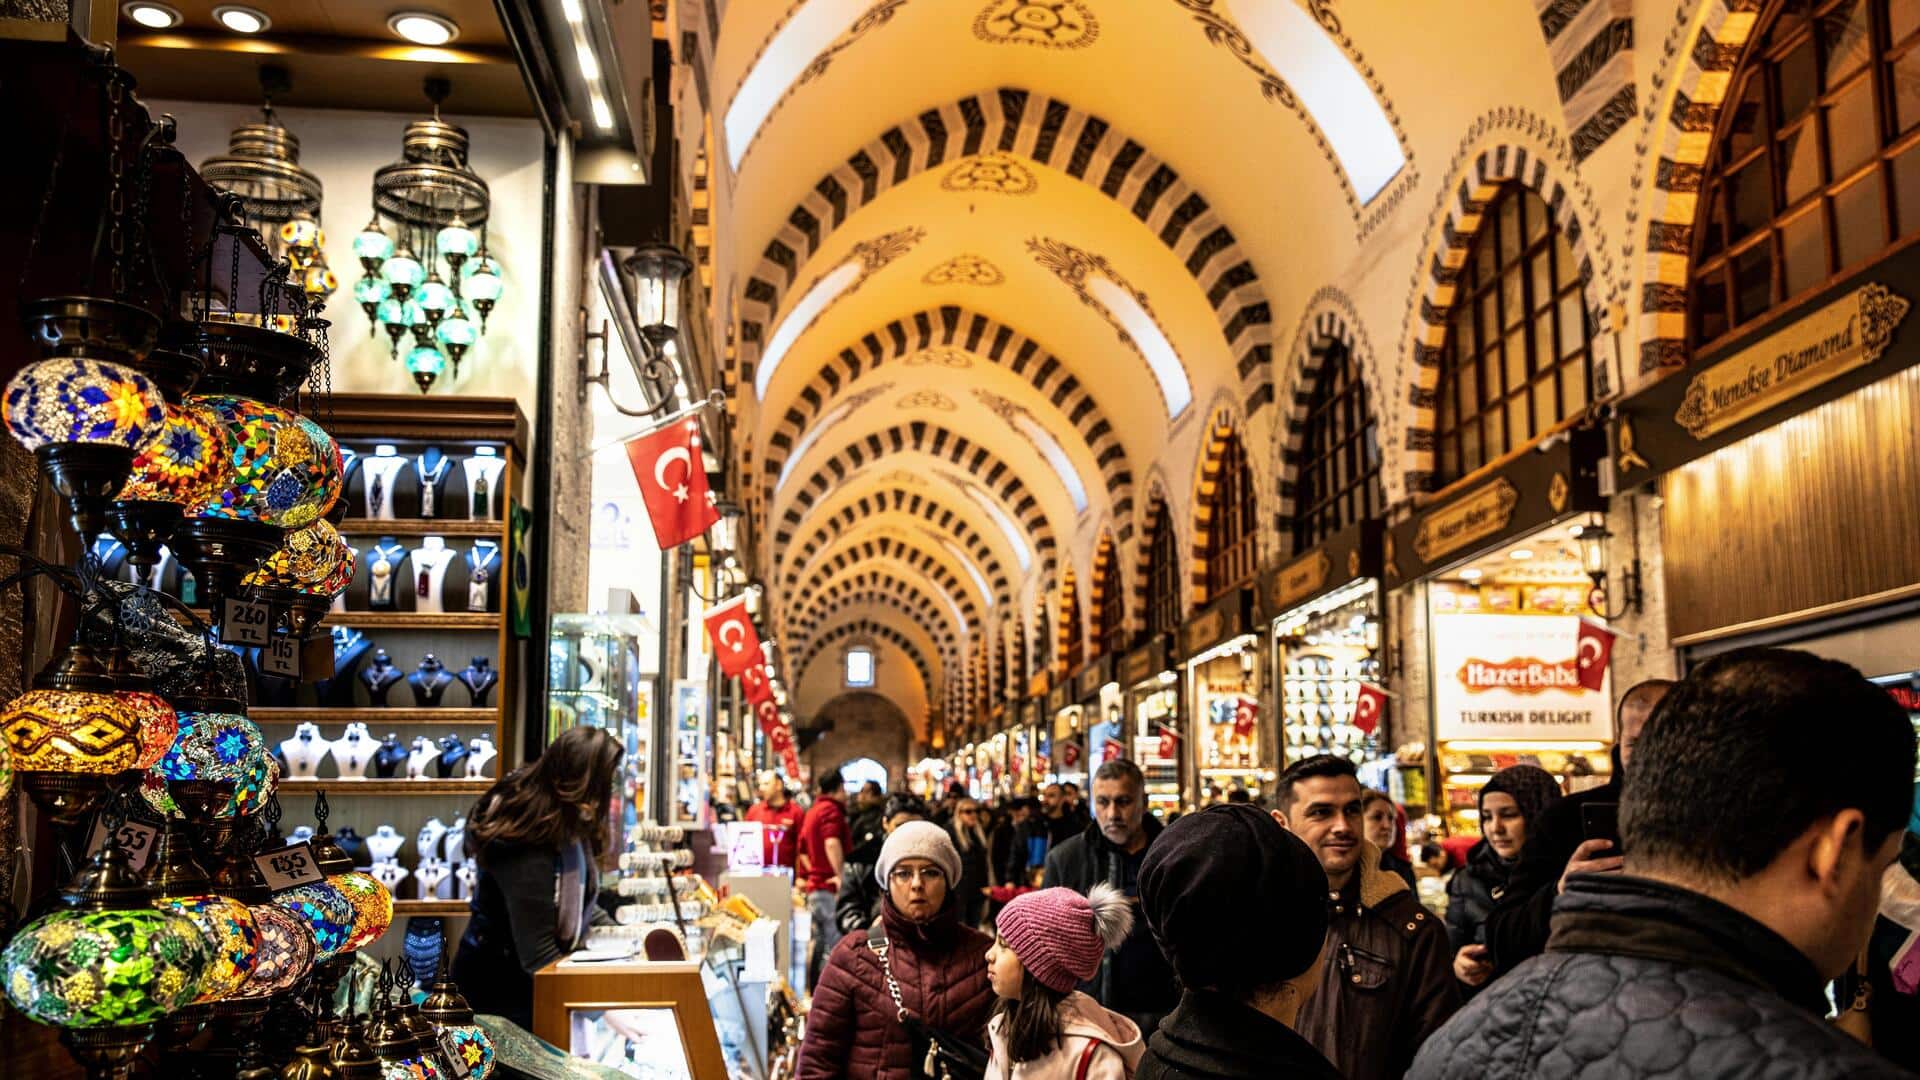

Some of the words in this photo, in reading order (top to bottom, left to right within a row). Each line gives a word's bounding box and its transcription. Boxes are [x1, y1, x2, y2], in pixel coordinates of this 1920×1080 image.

[1774, 313, 1856, 383] Diamond
[239, 628, 262, 641] TL
[274, 660, 291, 670] TL
[1460, 710, 1525, 725] TURKISH
[1528, 710, 1593, 725] DELIGHT
[285, 868, 311, 880] TL
